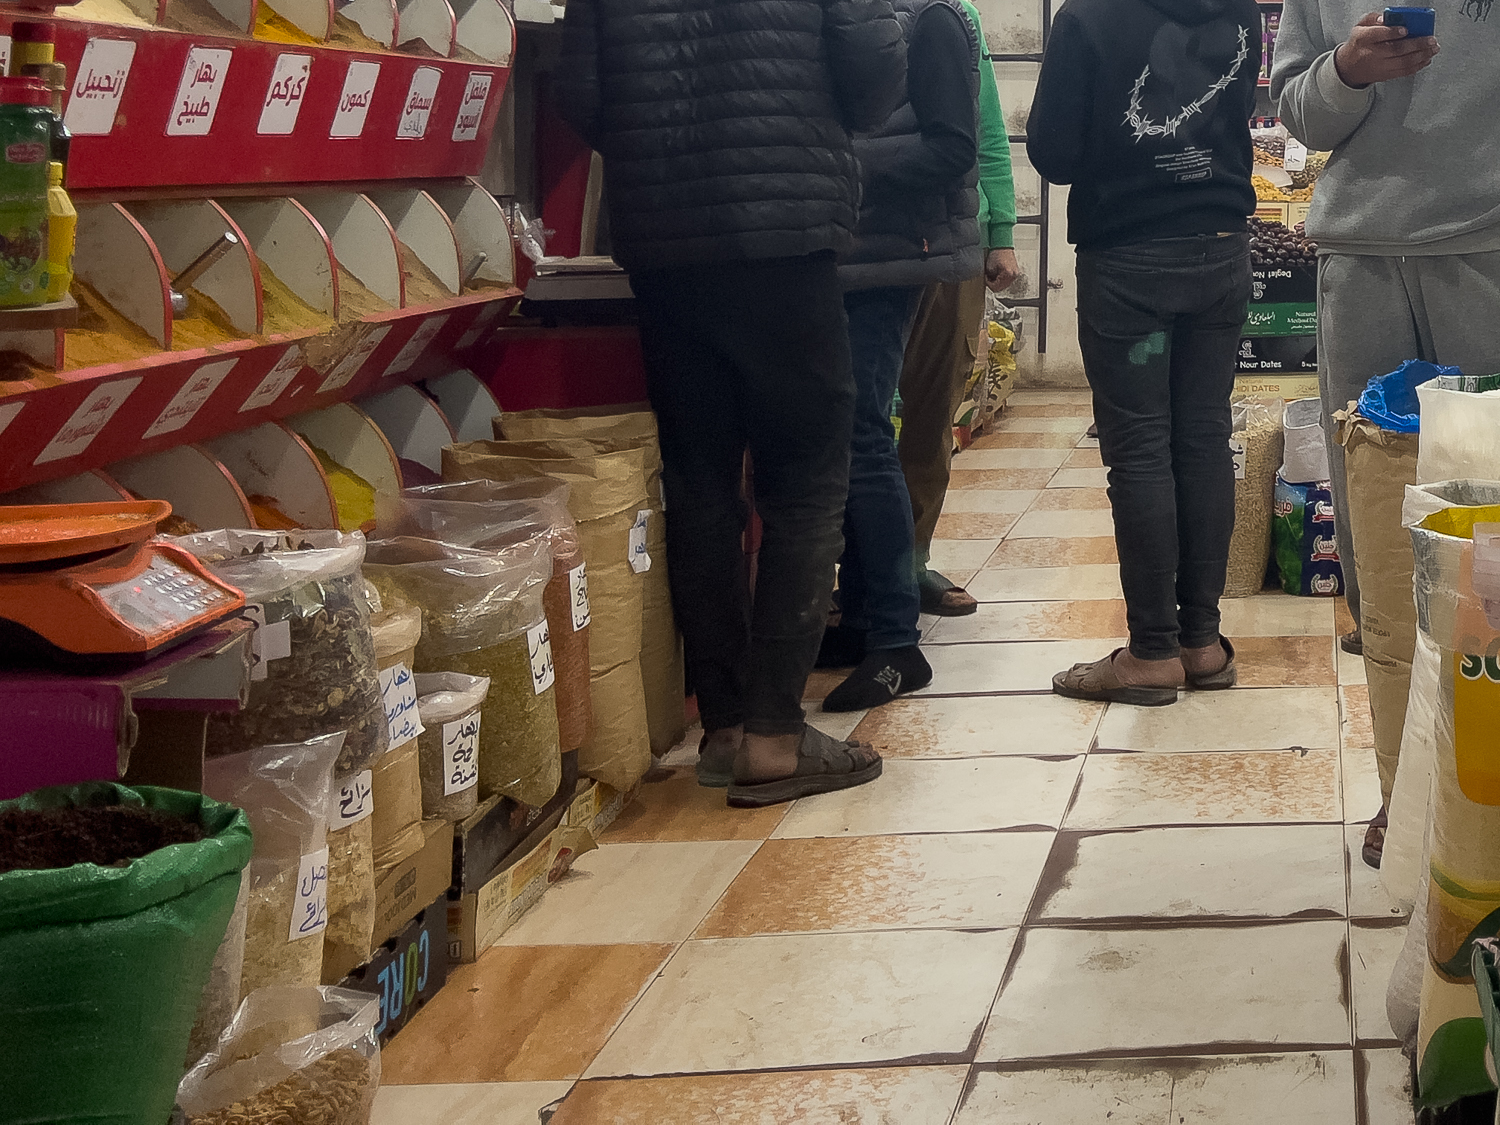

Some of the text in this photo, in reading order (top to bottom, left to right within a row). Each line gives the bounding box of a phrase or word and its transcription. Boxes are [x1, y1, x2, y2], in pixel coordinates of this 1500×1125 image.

[75, 68, 125, 99] زنجبيل
[190, 62, 217, 89] بهار
[266, 76, 306, 107] كركم
[340, 90, 370, 112] كمون
[406, 91, 432, 116] سماق
[177, 95, 210, 126] طبيخ
[1268, 268, 1292, 278] Deglet
[1240, 361, 1258, 369] Nour
[1260, 361, 1282, 369] Dates
